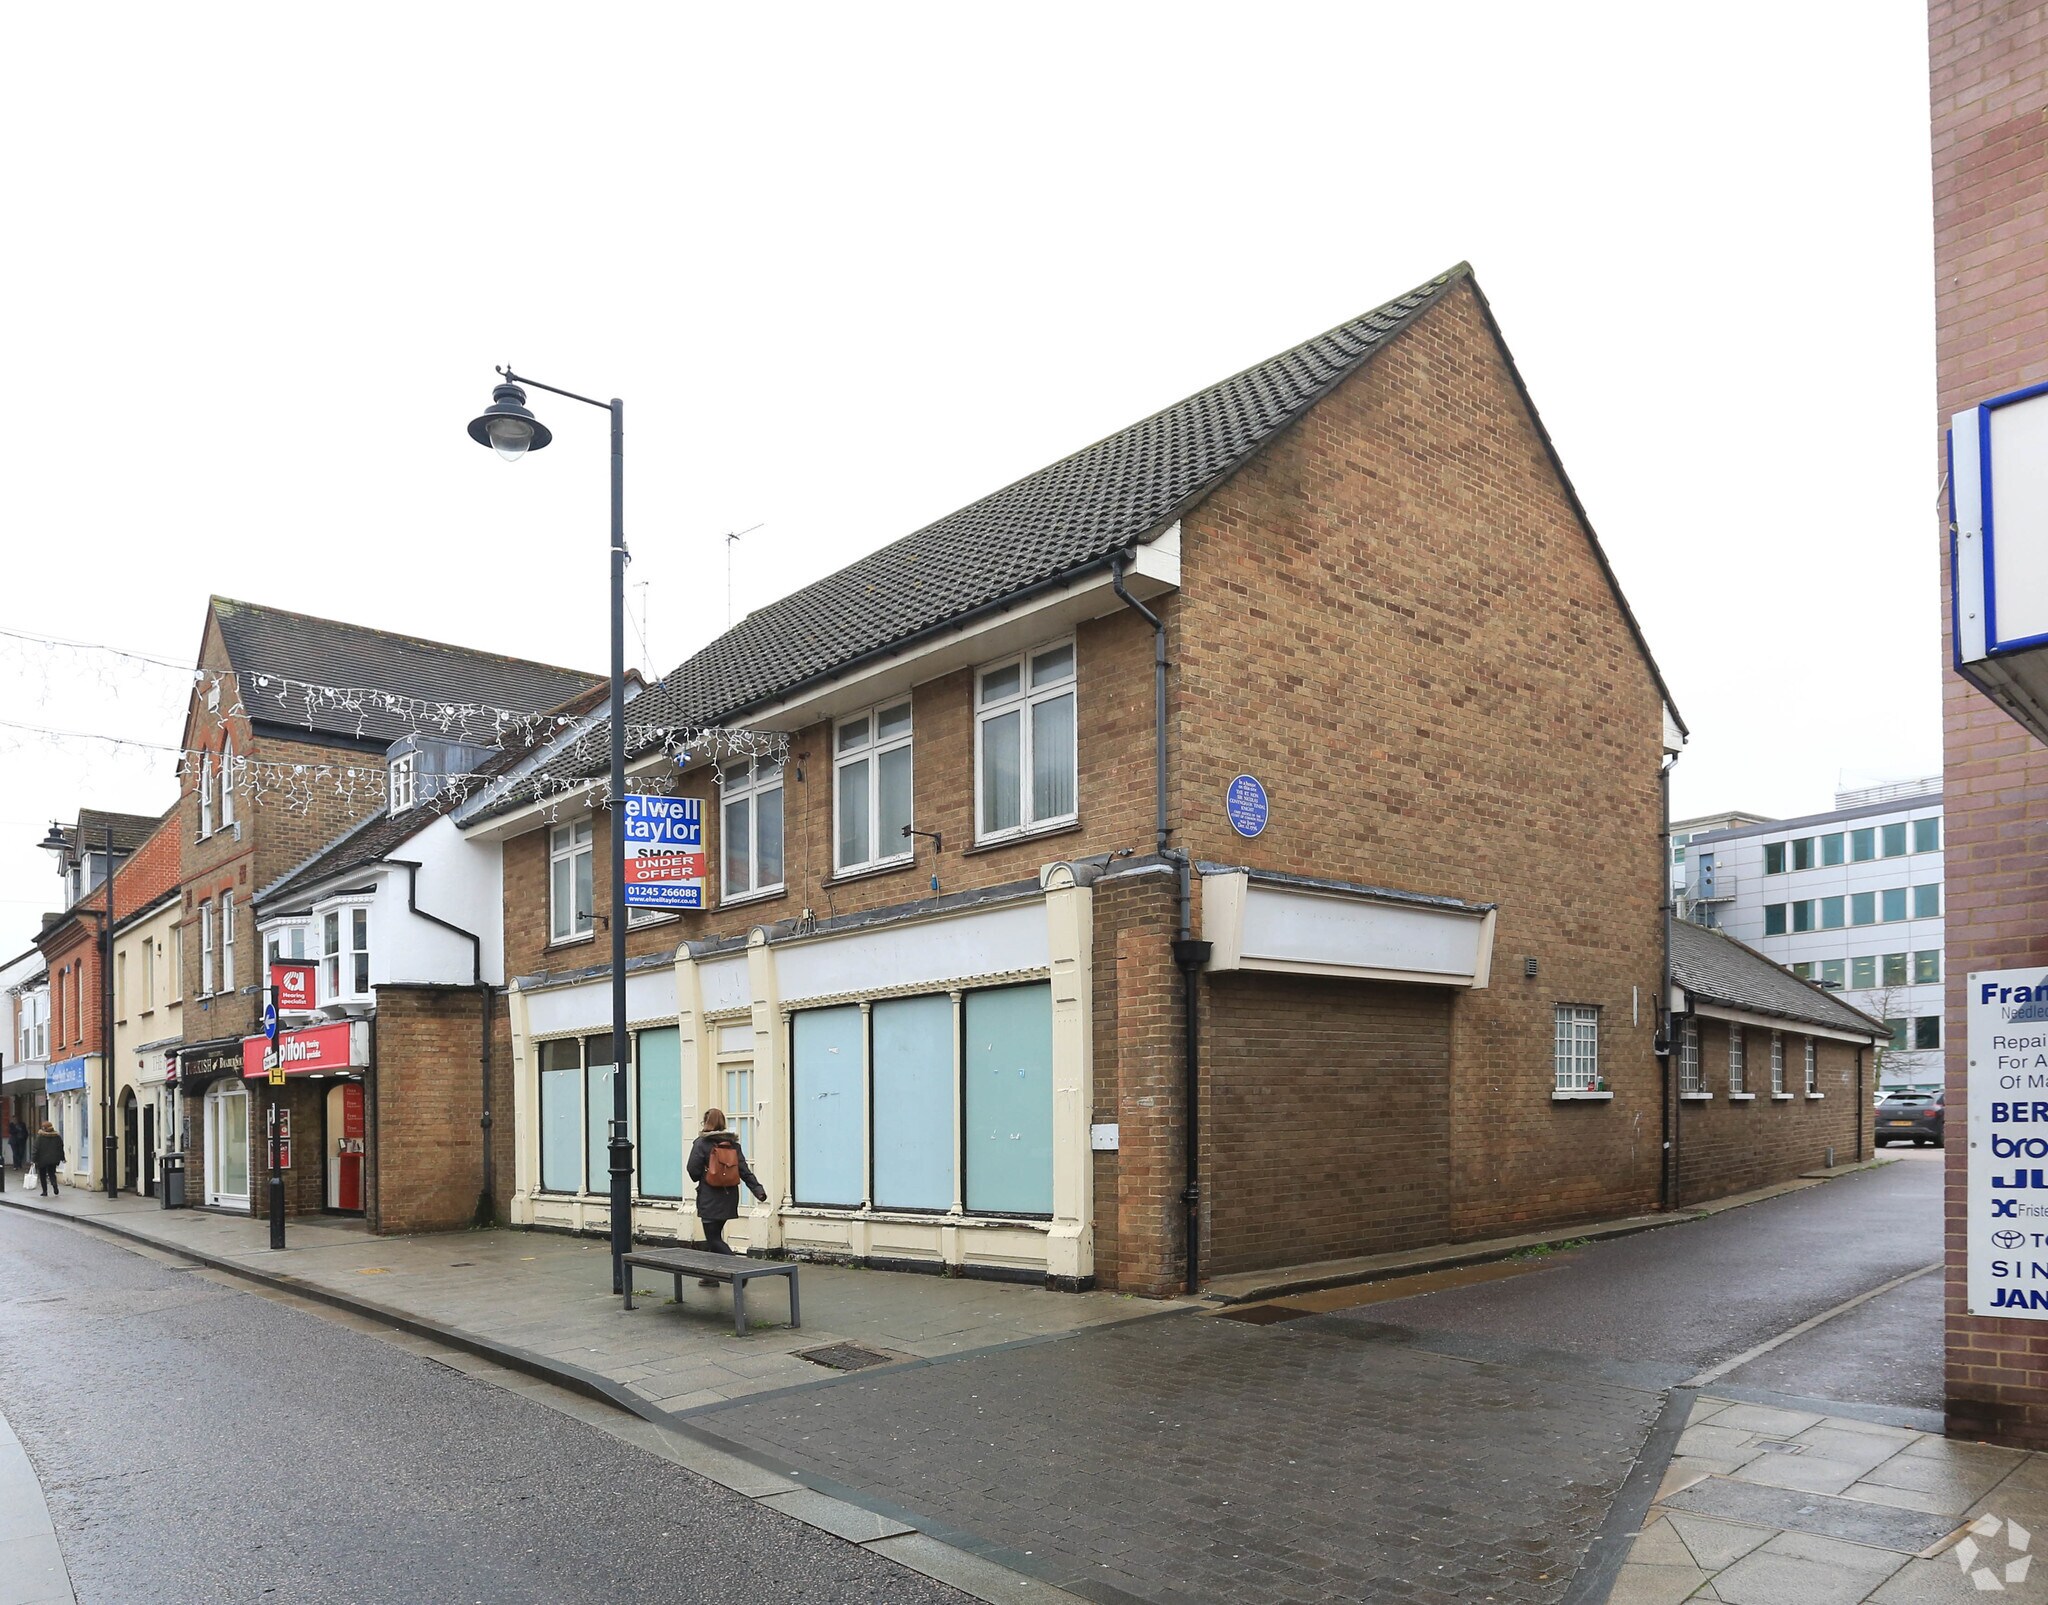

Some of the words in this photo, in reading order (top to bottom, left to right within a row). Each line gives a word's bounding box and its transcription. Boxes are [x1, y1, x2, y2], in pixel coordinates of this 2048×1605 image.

[625, 795, 698, 820] elwell
[624, 816, 700, 843] taylor
[635, 856, 695, 869] UNDER
[636, 867, 694, 880] OFFER
[628, 886, 659, 896] 01245
[661, 887, 698, 898] 266088
[1993, 1033, 2046, 1052] Repai
[1998, 1055, 2029, 1070] For
[2000, 1074, 2021, 1090] Of
[2028, 1074, 2048, 1088] M
[1992, 1102, 2048, 1123] BER
[1992, 1133, 2048, 1159] bro
[2030, 1233, 2048, 1248] T
[1992, 1260, 2048, 1280] SIN
[1990, 1287, 2048, 1311] JAN
